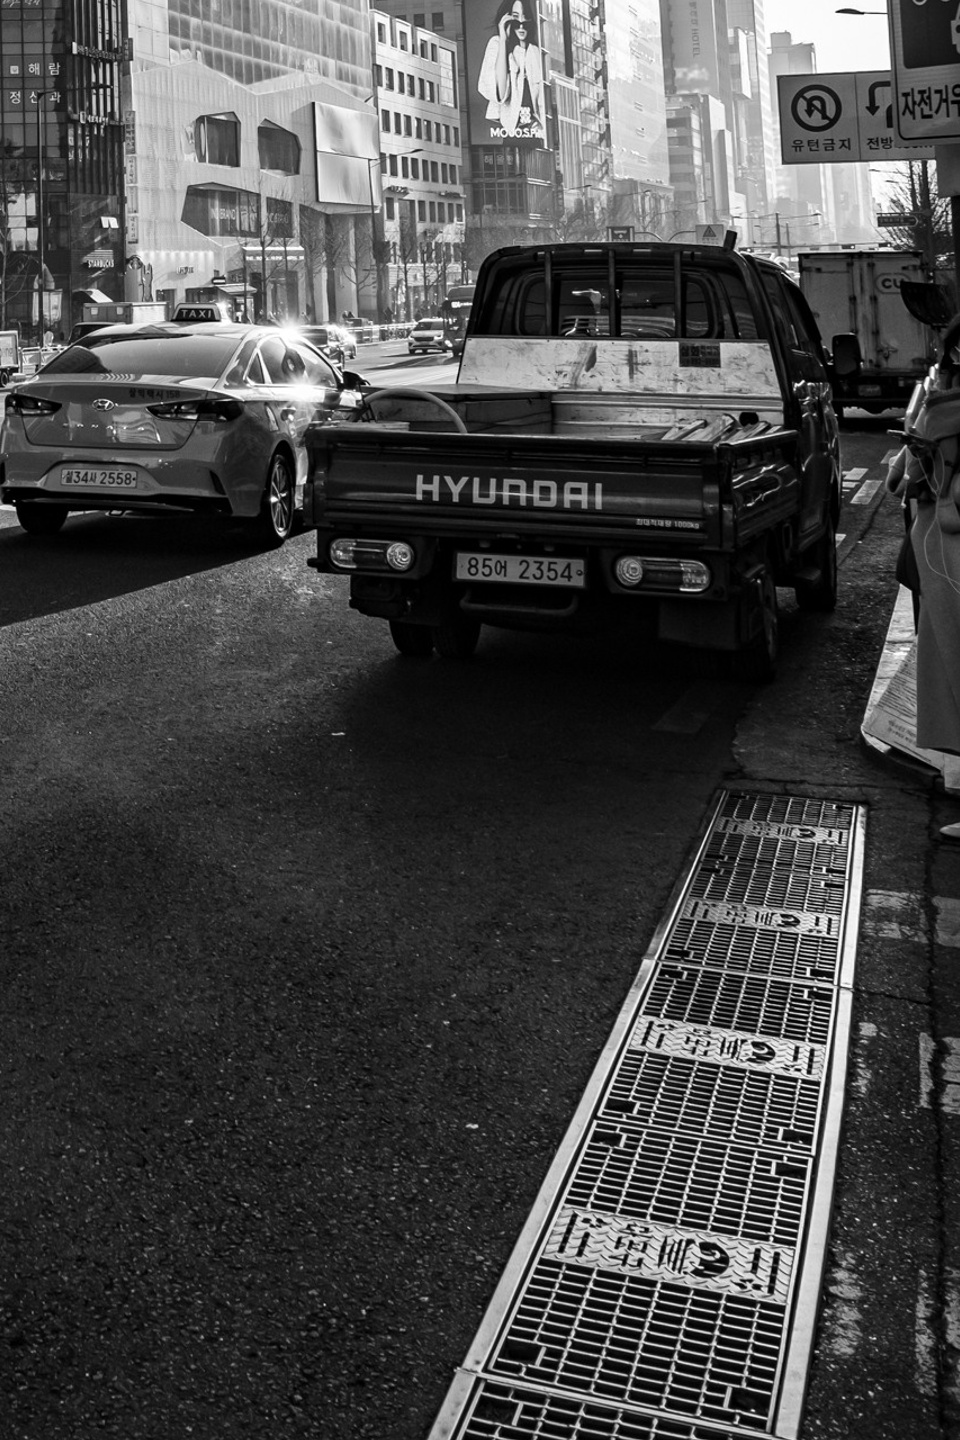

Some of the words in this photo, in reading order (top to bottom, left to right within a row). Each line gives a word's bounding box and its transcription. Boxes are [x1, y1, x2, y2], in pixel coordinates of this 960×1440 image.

[691, 28, 701, 58] HOTEL
[28, 62, 61, 76] 해람
[791, 137, 852, 153] 유턴금지
[881, 277, 904, 289] CU
[180, 309, 212, 318] TAXI
[166, 389, 181, 399] 158
[100, 471, 132, 485] 2558
[415, 474, 604, 511] HYUNDAI
[674, 520, 700, 530] 1000kg
[518, 559, 573, 582] 2354
